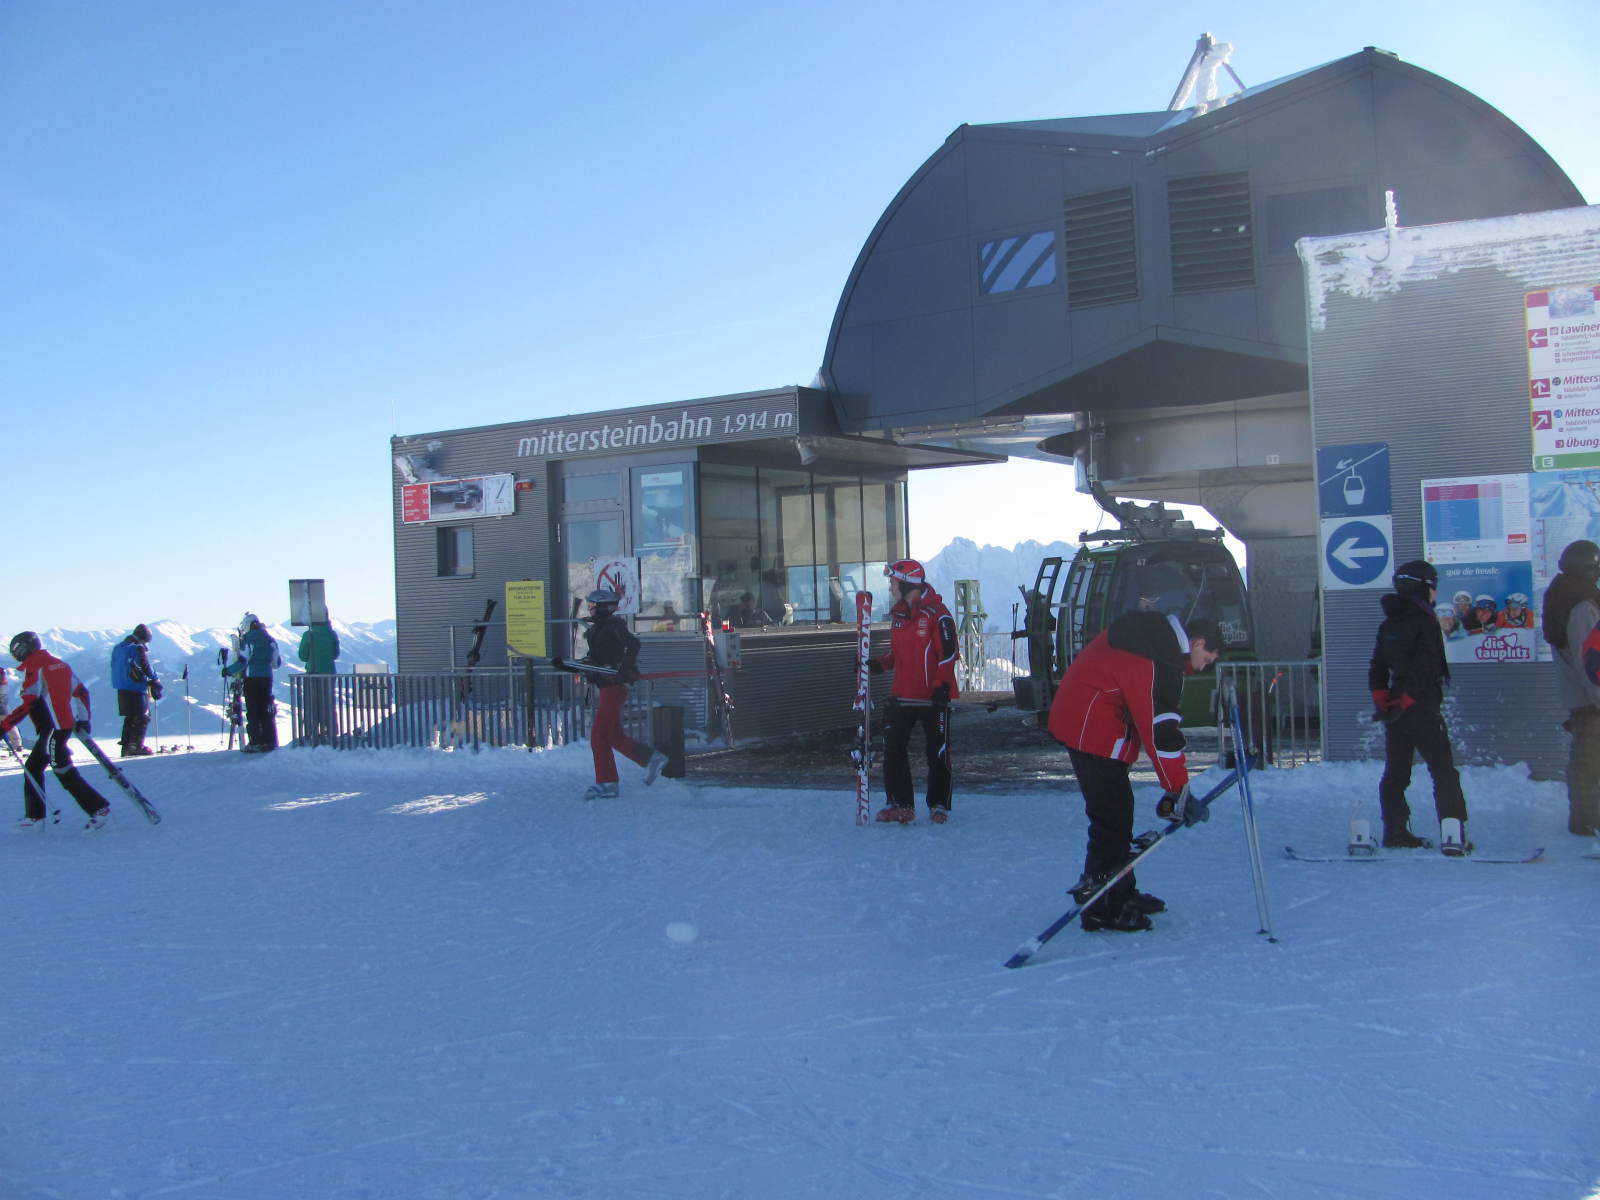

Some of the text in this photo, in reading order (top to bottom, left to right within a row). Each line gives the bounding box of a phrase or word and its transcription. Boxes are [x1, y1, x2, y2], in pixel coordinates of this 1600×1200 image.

[1563, 374, 1600, 385] Mitters
[518, 410, 793, 457] mittersteinbahn 1.914 m
[1566, 434, 1600, 450] Übung
[1484, 637, 1505, 649] die
[1477, 646, 1529, 661] tauplitz
